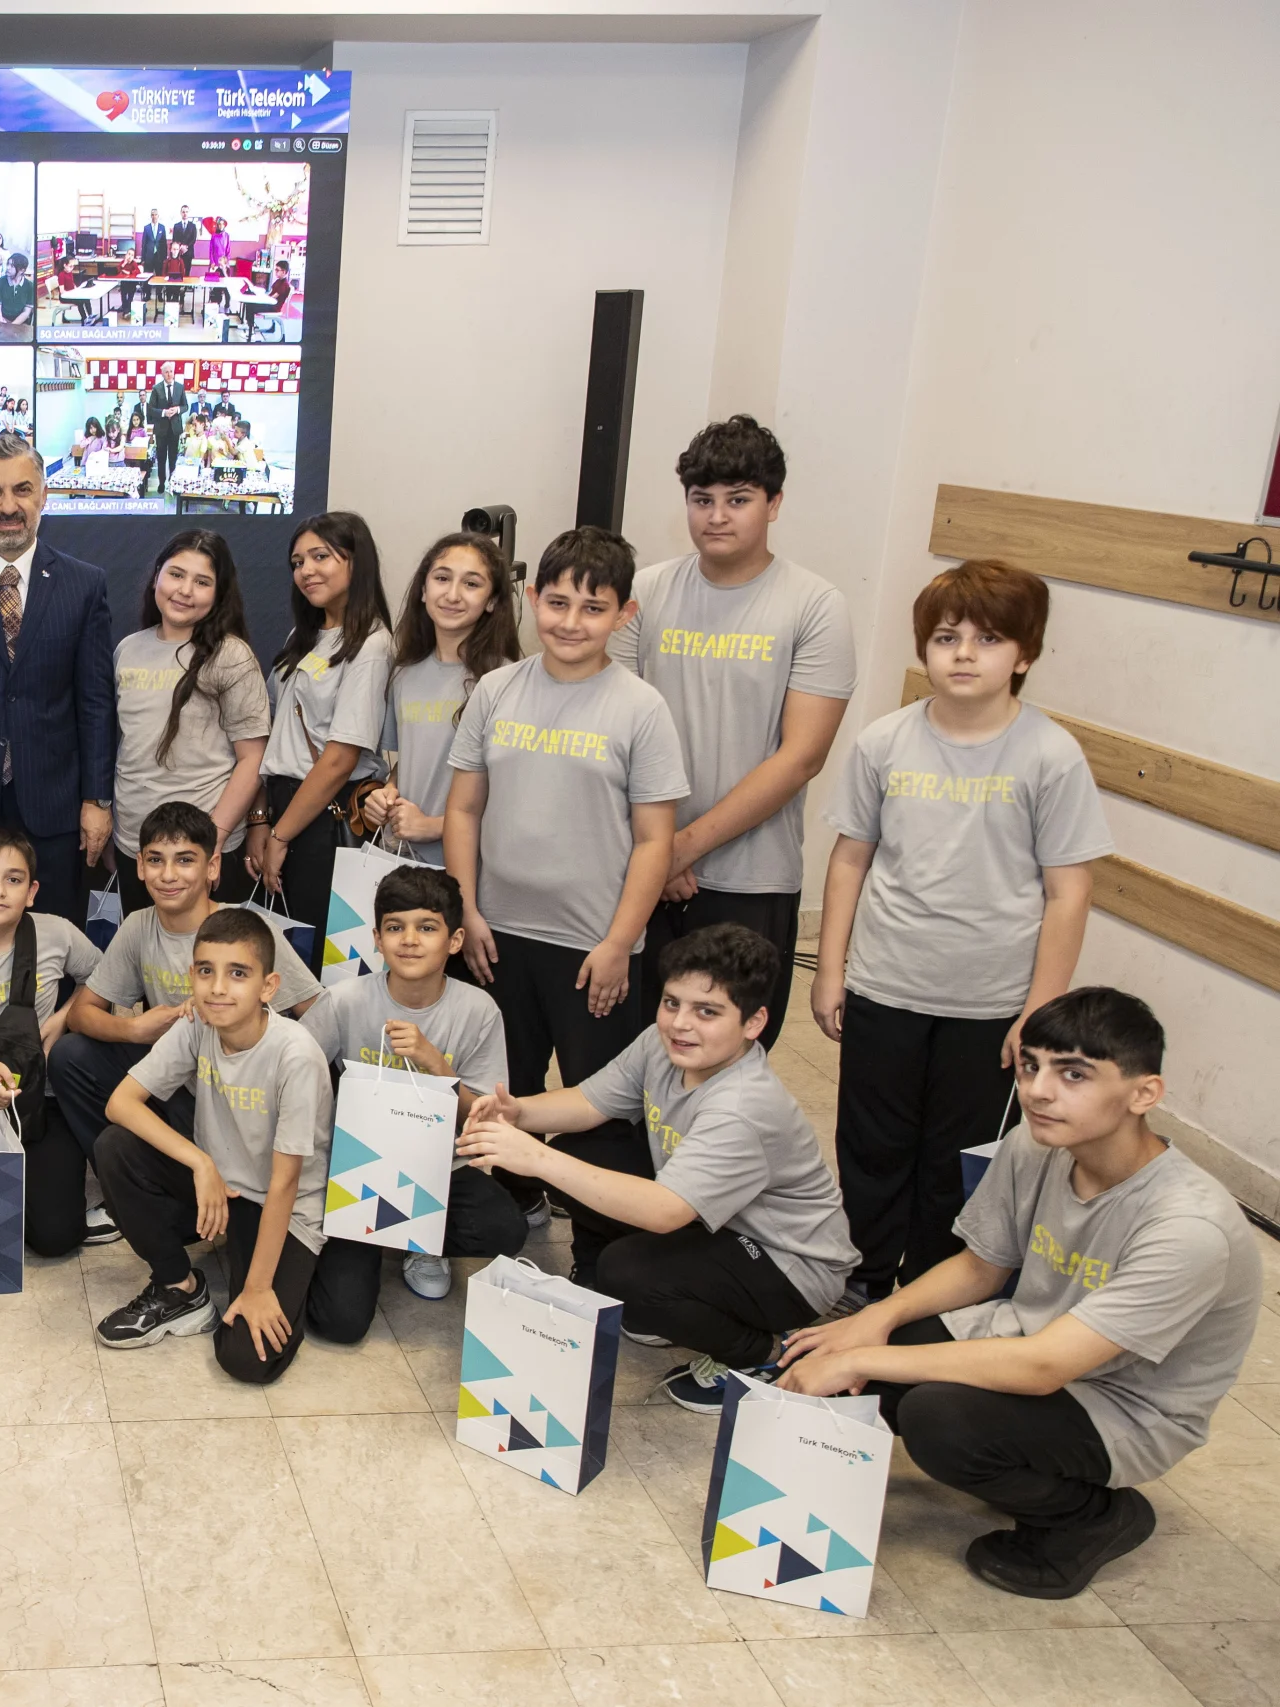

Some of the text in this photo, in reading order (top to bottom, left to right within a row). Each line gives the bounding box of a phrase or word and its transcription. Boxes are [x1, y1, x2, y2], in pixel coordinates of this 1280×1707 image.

[132, 87, 195, 105] TÜRKİYE'YE
[216, 88, 305, 107] Türk Telekom
[132, 106, 169, 124] DEĞER
[218, 108, 240, 118] Değerli
[40, 330, 51, 339] 5G
[54, 330, 80, 339] CANLI
[82, 329, 126, 339] BAĞLANTI
[132, 330, 162, 339] AFYON
[51, 502, 76, 510] CANLI
[78, 501, 119, 510] BAĞLANTI
[125, 502, 159, 510] ISPARTA
[660, 628, 775, 661] SEYRANTEPE
[492, 720, 608, 761] SEYRANTEPE
[390, 1108, 434, 1122] Türk Telekom
[522, 1324, 568, 1347] Türk Telekom
[798, 1436, 858, 1460] Türk Telekom
